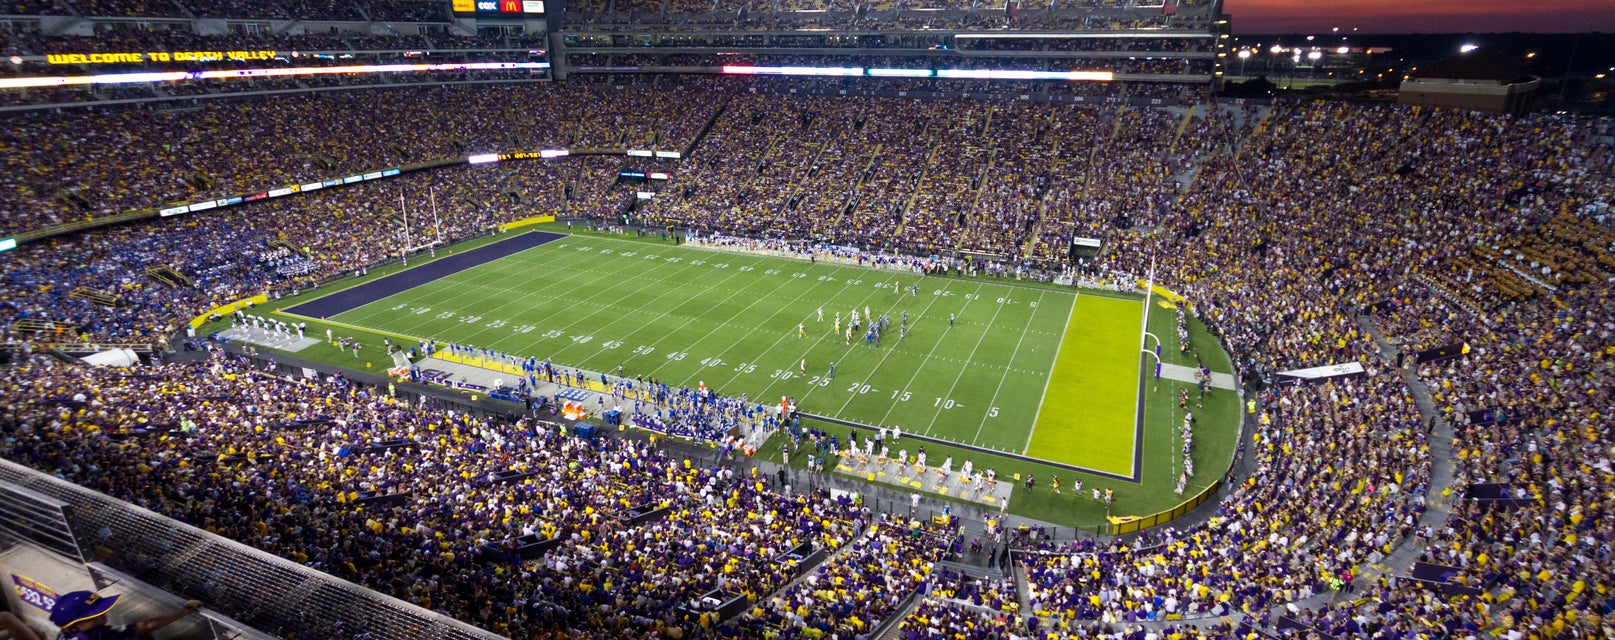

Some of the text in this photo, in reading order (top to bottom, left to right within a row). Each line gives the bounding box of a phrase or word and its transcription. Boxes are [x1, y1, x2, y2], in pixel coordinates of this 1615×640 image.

[47, 50, 276, 64] WELCOME TO DEATH VALLEY
[541, 329, 565, 338] 35
[602, 340, 624, 350] 45
[632, 345, 655, 355] 50
[666, 351, 688, 361] 45
[700, 357, 721, 367] 40
[734, 363, 757, 374] 35
[770, 369, 793, 380] 30
[807, 375, 832, 387] 25
[847, 382, 871, 394] 20
[890, 389, 912, 402] 15
[933, 397, 955, 410] 10
[988, 406, 1000, 418] 5
